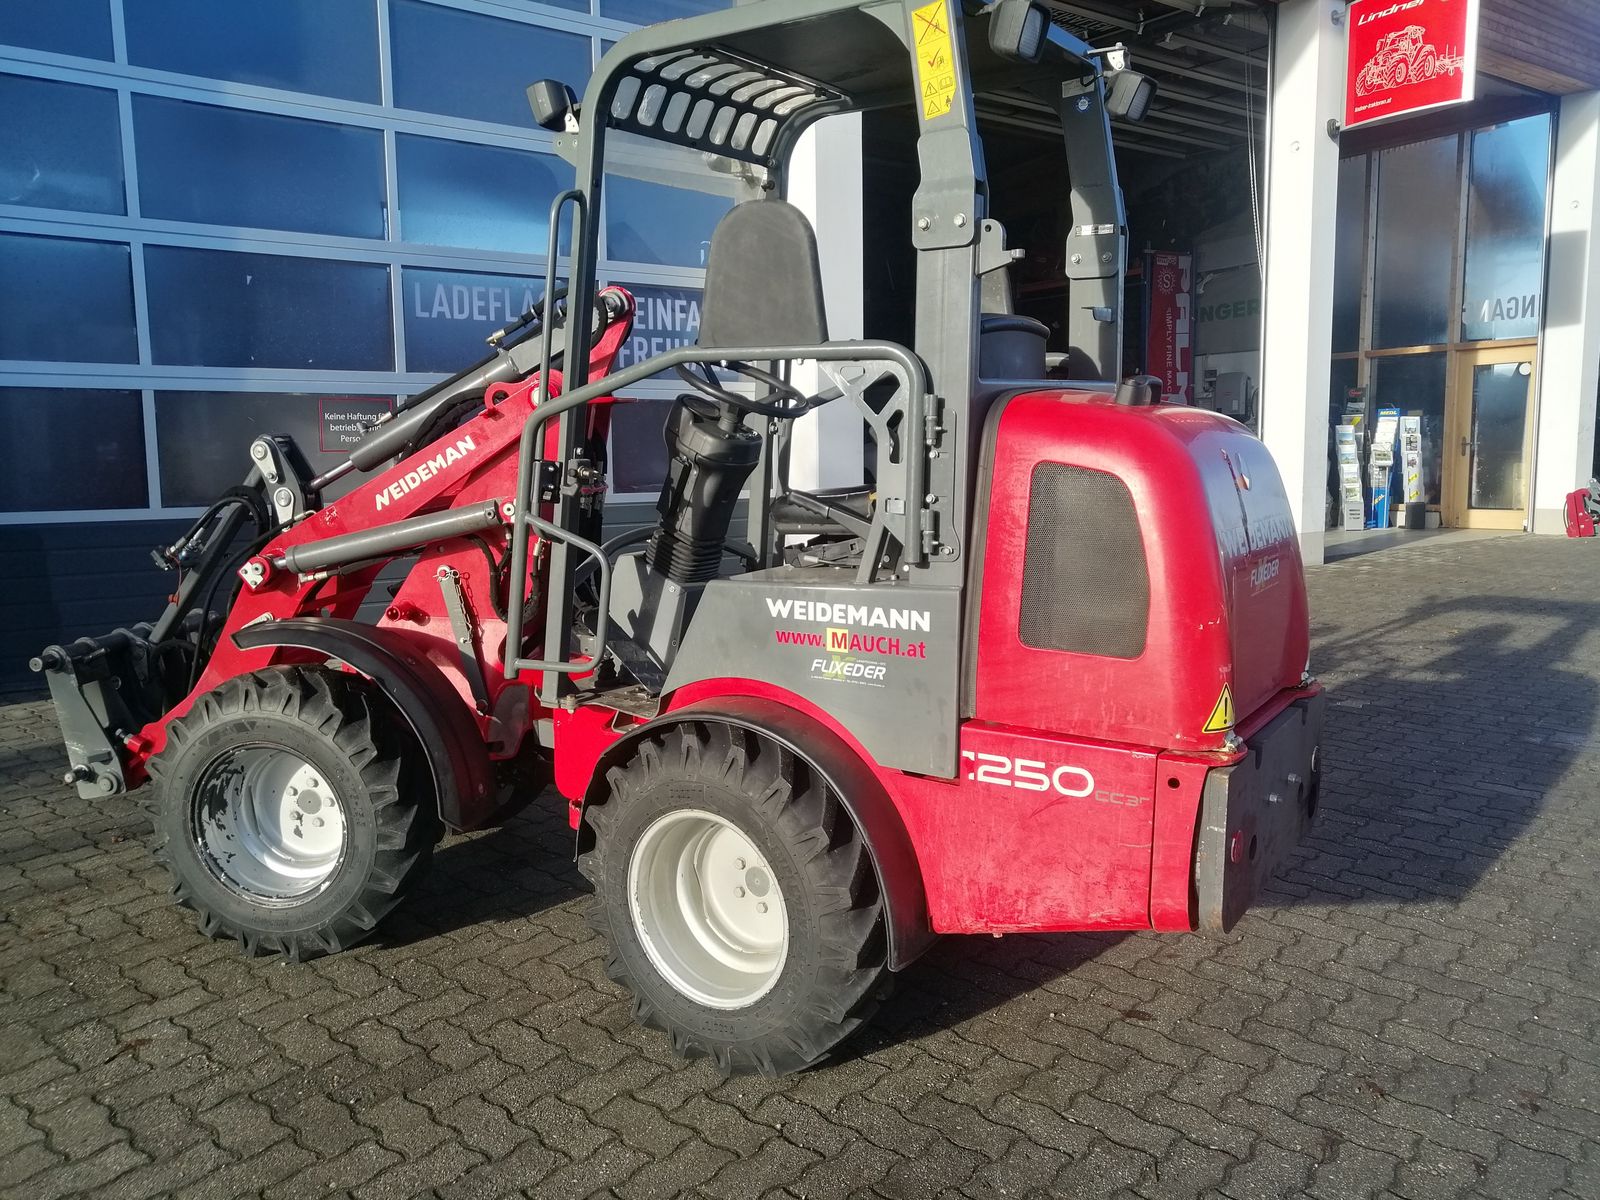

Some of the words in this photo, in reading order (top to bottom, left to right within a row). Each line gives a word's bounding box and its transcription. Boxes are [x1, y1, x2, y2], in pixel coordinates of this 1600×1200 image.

[414, 282, 544, 323] LADEFLÄ
[324, 412, 345, 420] Keine
[347, 412, 377, 421] Haftung
[765, 597, 931, 632] WEIDEMANN
[775, 630, 927, 659] www.MAUCH.at
[811, 658, 887, 680] FLIXEDER
